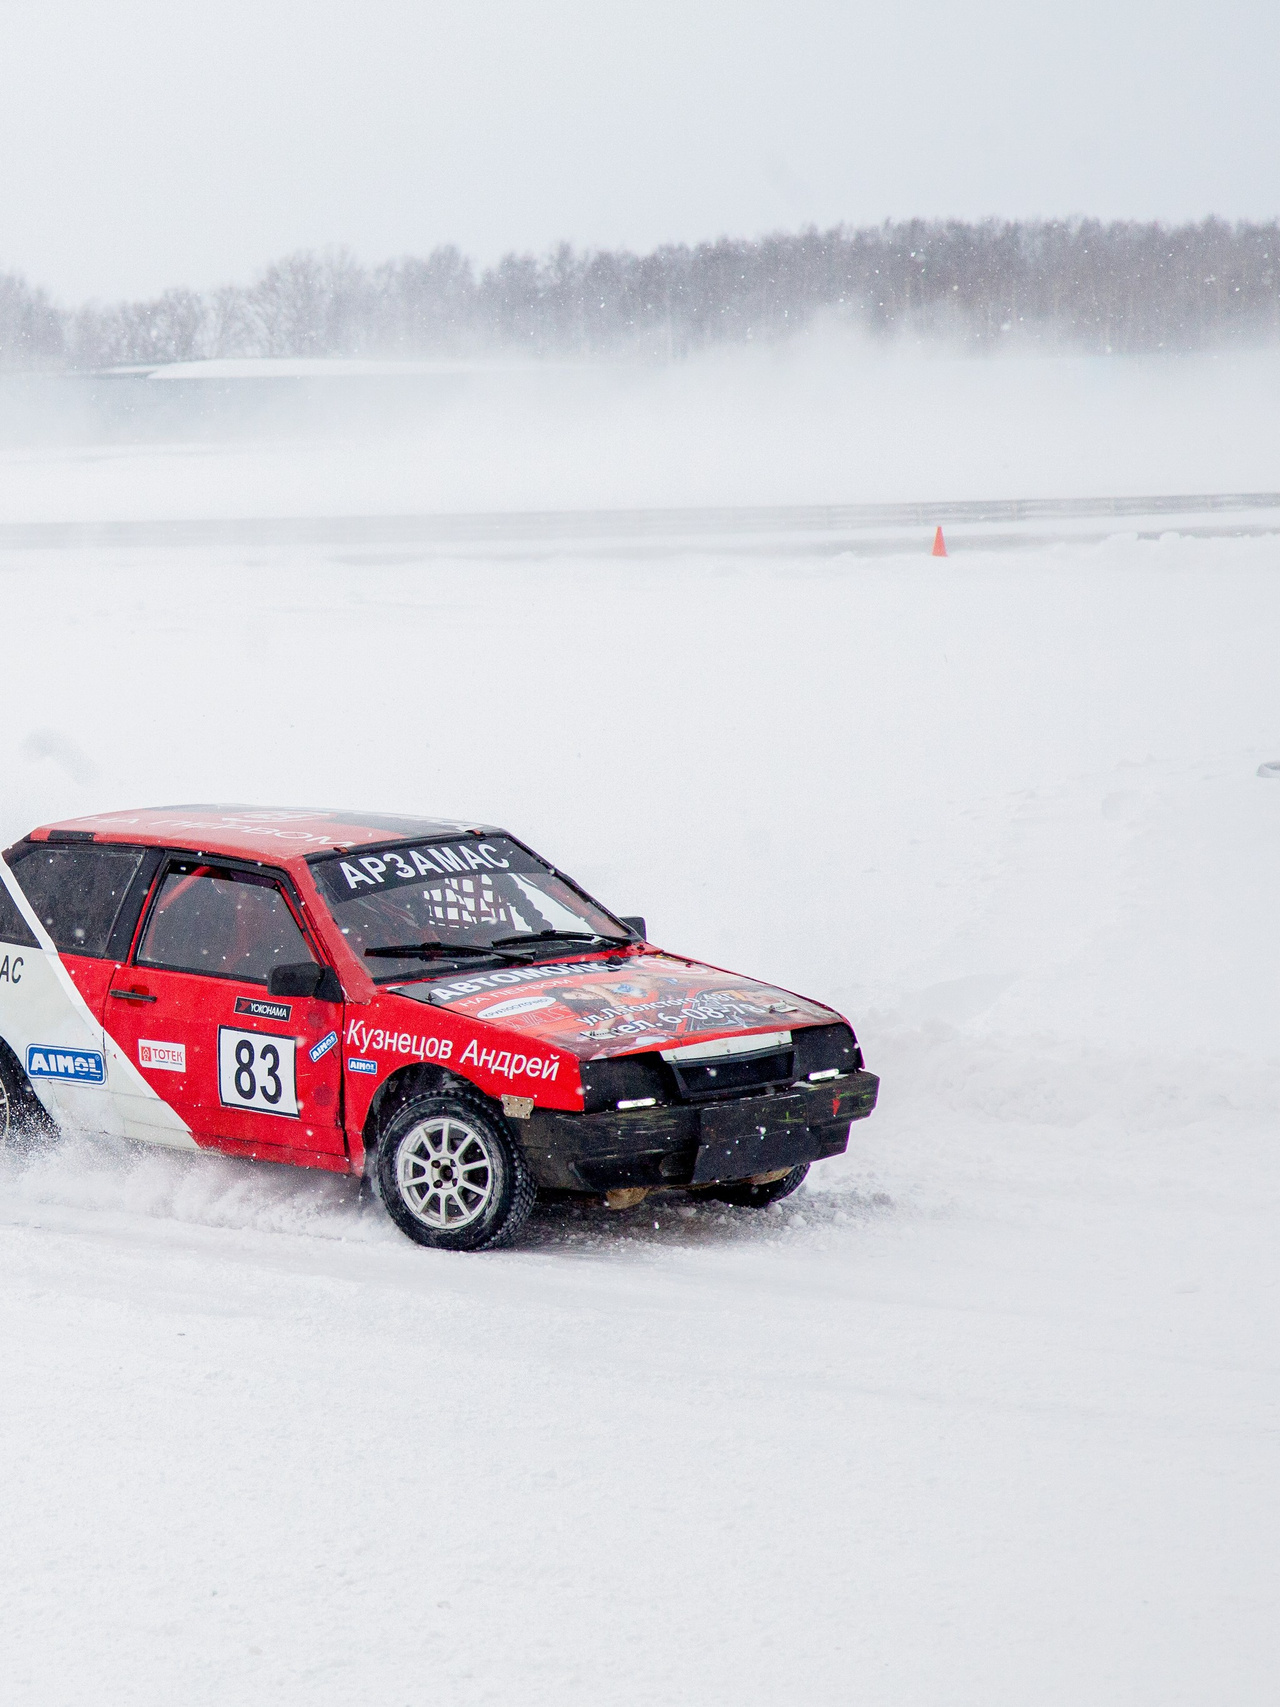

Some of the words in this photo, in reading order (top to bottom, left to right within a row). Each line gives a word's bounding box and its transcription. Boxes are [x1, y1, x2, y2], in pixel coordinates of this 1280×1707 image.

[338, 843, 510, 890] АРЗАМАС
[250, 1002, 288, 1018] YOKOHAMA
[459, 996, 488, 1008] НА
[489, 979, 574, 999] ПЕРВОМ
[30, 1052, 103, 1079] AIMOL
[346, 1018, 453, 1060] Кузнецов
[459, 1038, 561, 1081] Андрей
[234, 1038, 283, 1105] 83
